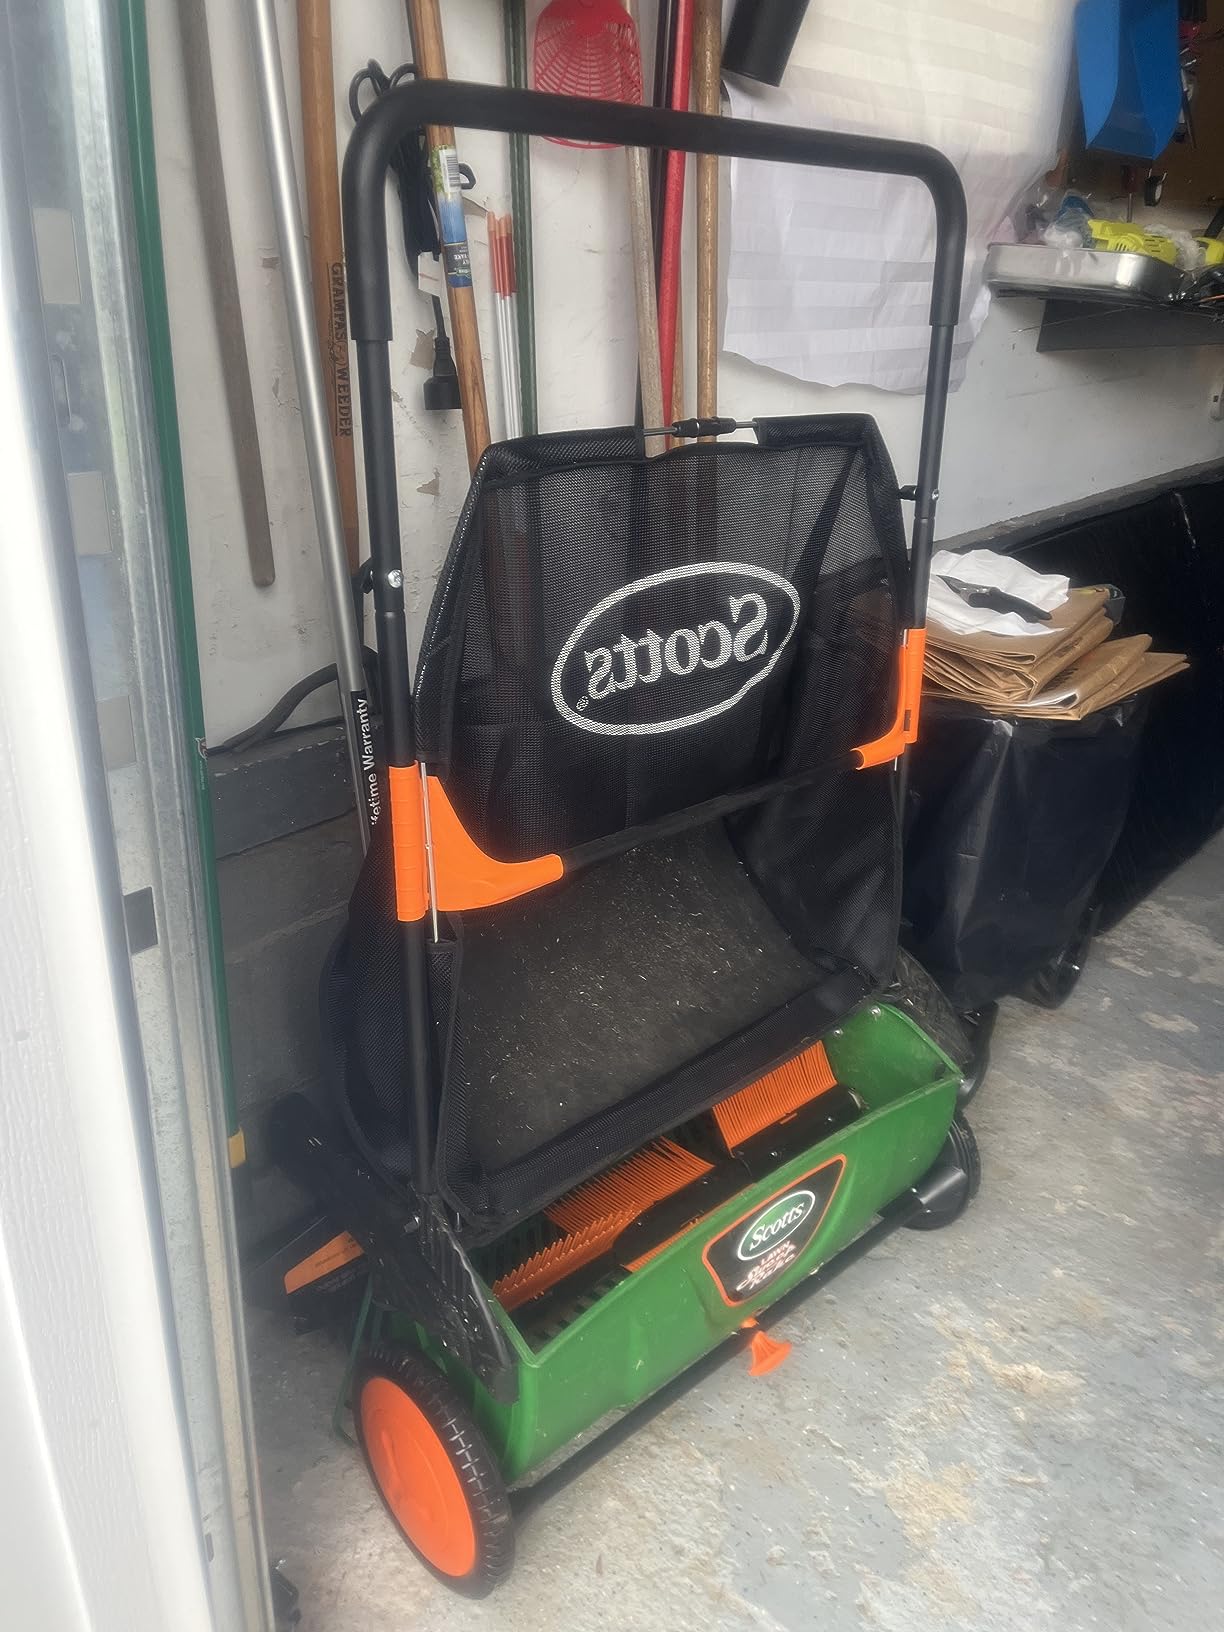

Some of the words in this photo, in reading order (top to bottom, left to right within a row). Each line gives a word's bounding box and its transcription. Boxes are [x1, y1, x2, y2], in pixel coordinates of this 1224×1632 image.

[336, 367, 352, 438] WEEDER
[356, 698, 375, 771] Warranty
[368, 773, 381, 825] fetime
[749, 1202, 805, 1252] Scotts
